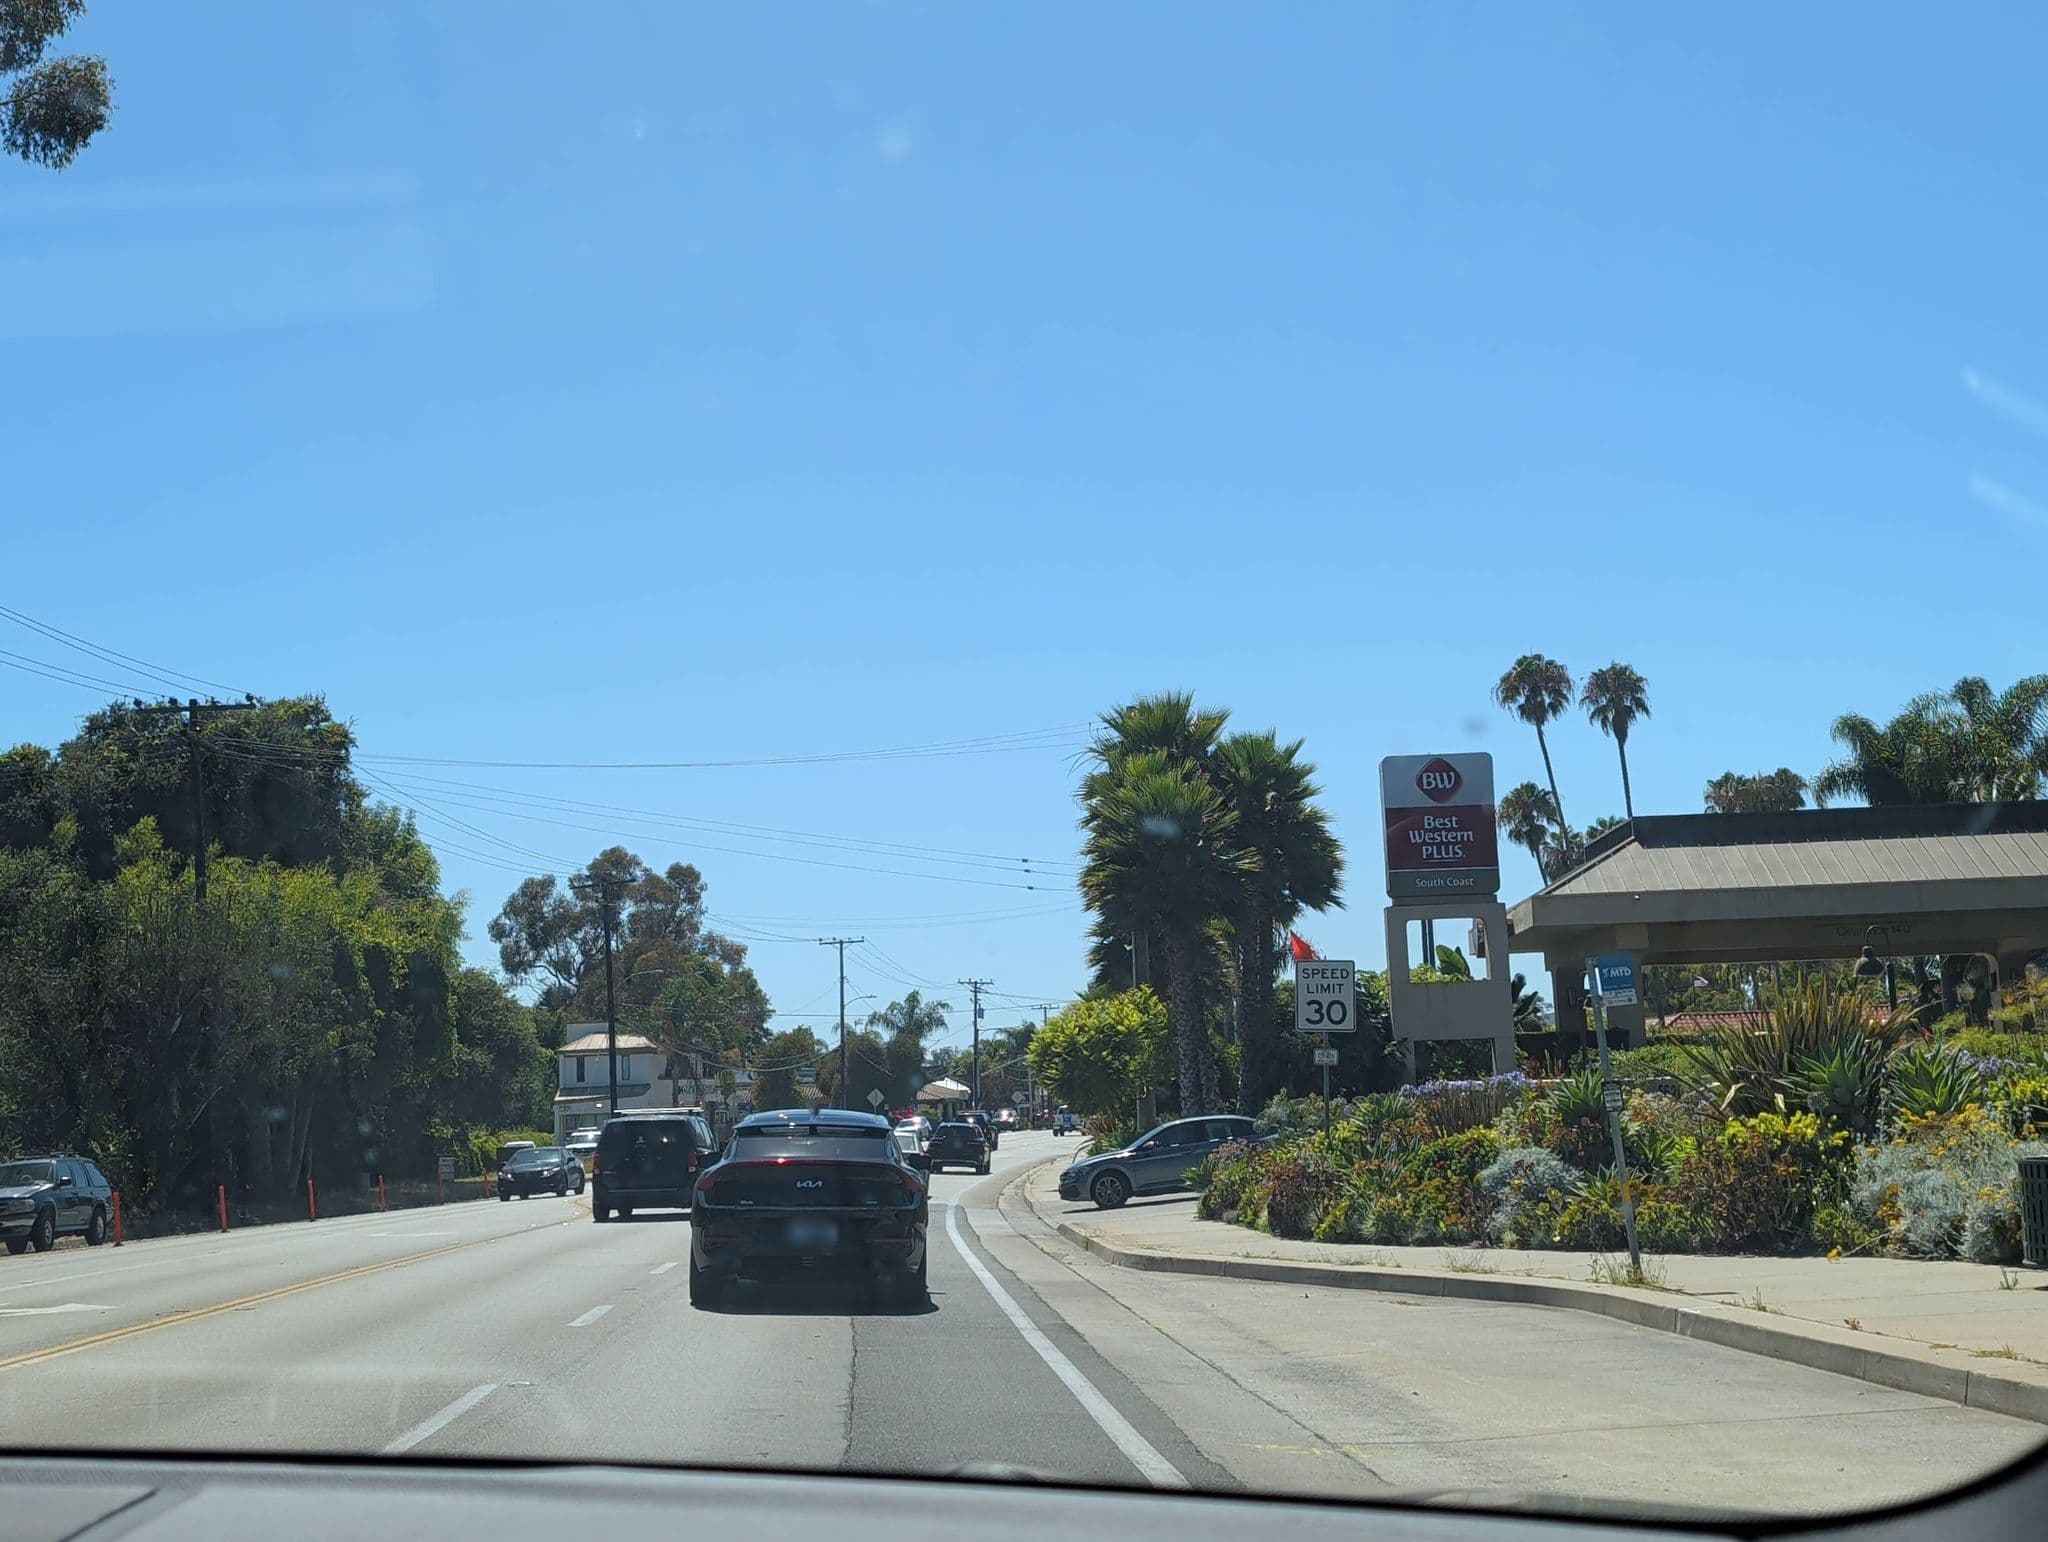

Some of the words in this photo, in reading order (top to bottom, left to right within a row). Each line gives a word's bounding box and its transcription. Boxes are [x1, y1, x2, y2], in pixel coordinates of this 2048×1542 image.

[1422, 772, 1455, 789] BW
[1424, 815, 1459, 829] Best
[1409, 830, 1474, 843] Western
[1423, 845, 1463, 859] PLUS
[1415, 877, 1444, 888] South
[1446, 877, 1474, 887] Coast
[1302, 968, 1350, 979] SPEED
[1610, 967, 1632, 977] MTD
[1306, 983, 1345, 994] LIMIT
[1305, 999, 1347, 1025] 30
